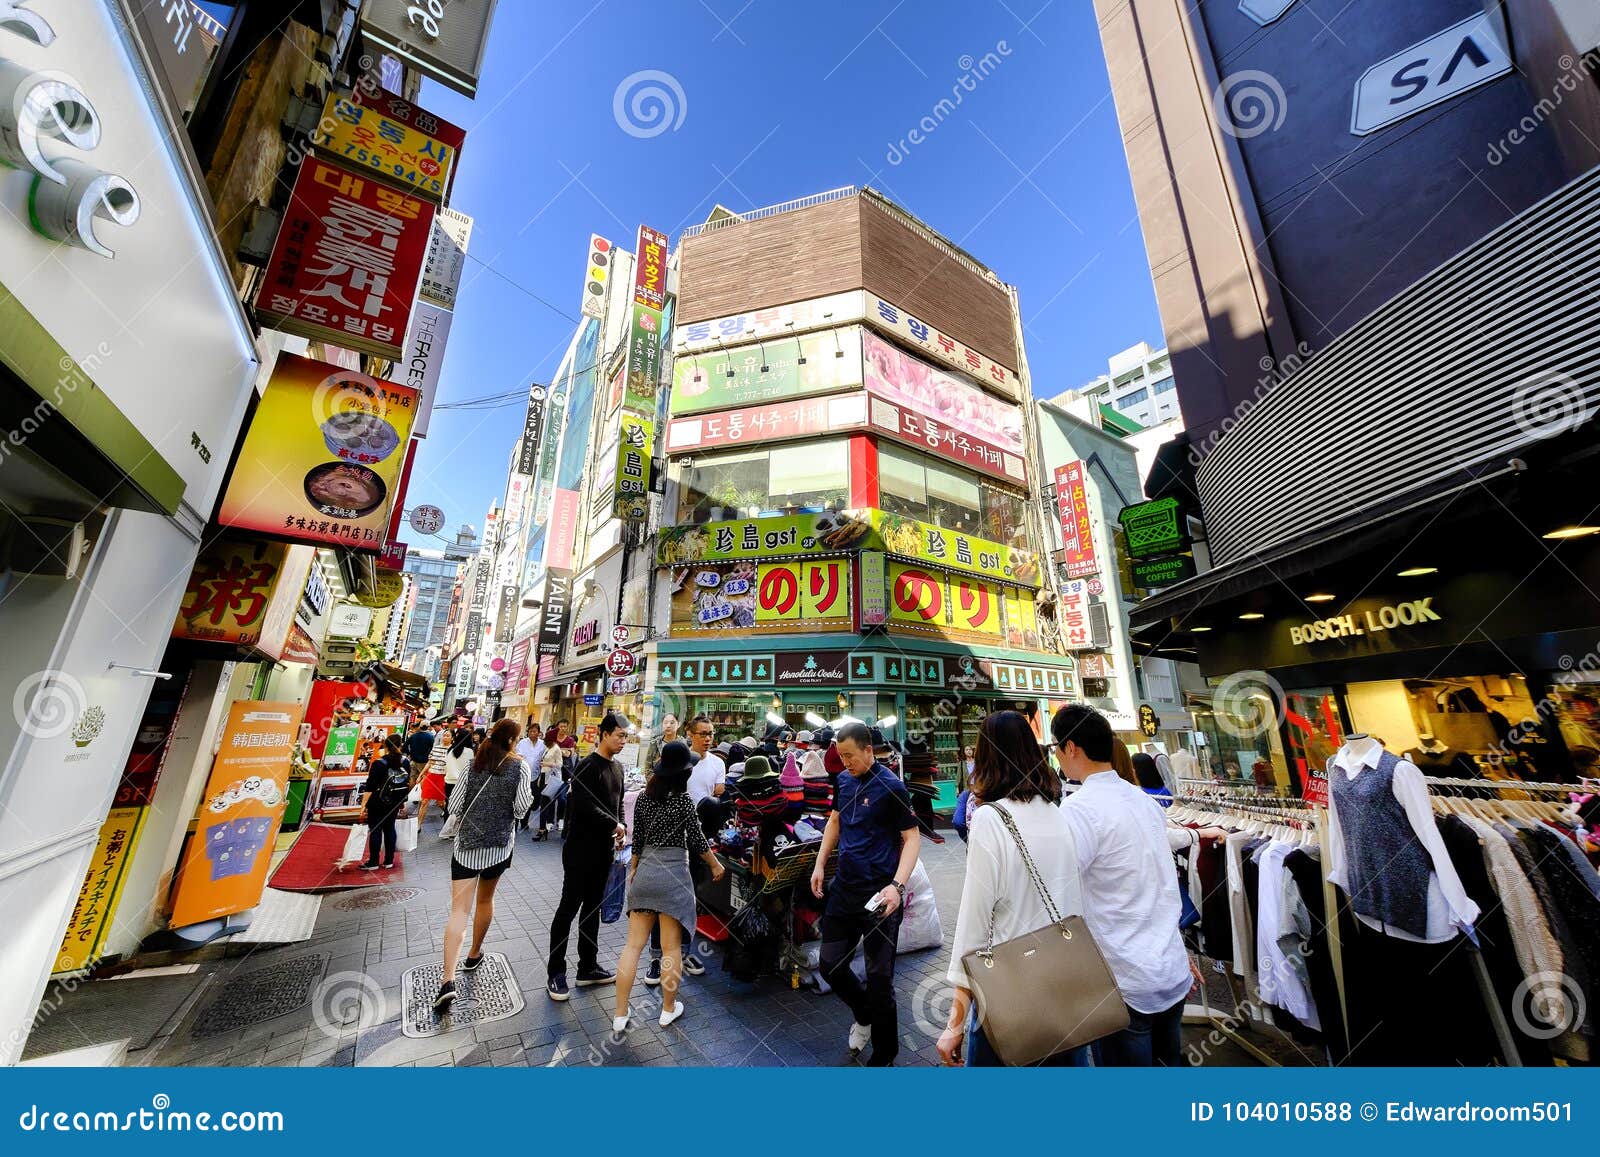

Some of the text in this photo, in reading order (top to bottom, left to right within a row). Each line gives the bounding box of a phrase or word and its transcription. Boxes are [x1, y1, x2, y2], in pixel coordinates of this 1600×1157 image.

[314, 165, 421, 219] 대명
[407, 315, 437, 391] THEFACES
[621, 479, 644, 494] gst
[716, 524, 797, 552] 珍島 gst
[979, 551, 1001, 569] gst
[1136, 560, 1183, 575] BEANSBINS
[759, 564, 839, 614] のり
[1146, 571, 1177, 582] COFFEE
[545, 576, 568, 635] TALENT
[894, 569, 990, 628] のり
[1064, 593, 1086, 645] 부동산
[1366, 597, 1442, 632] LOOK
[779, 668, 844, 680] Honolulu Cookie
[1313, 770, 1329, 778] SAL
